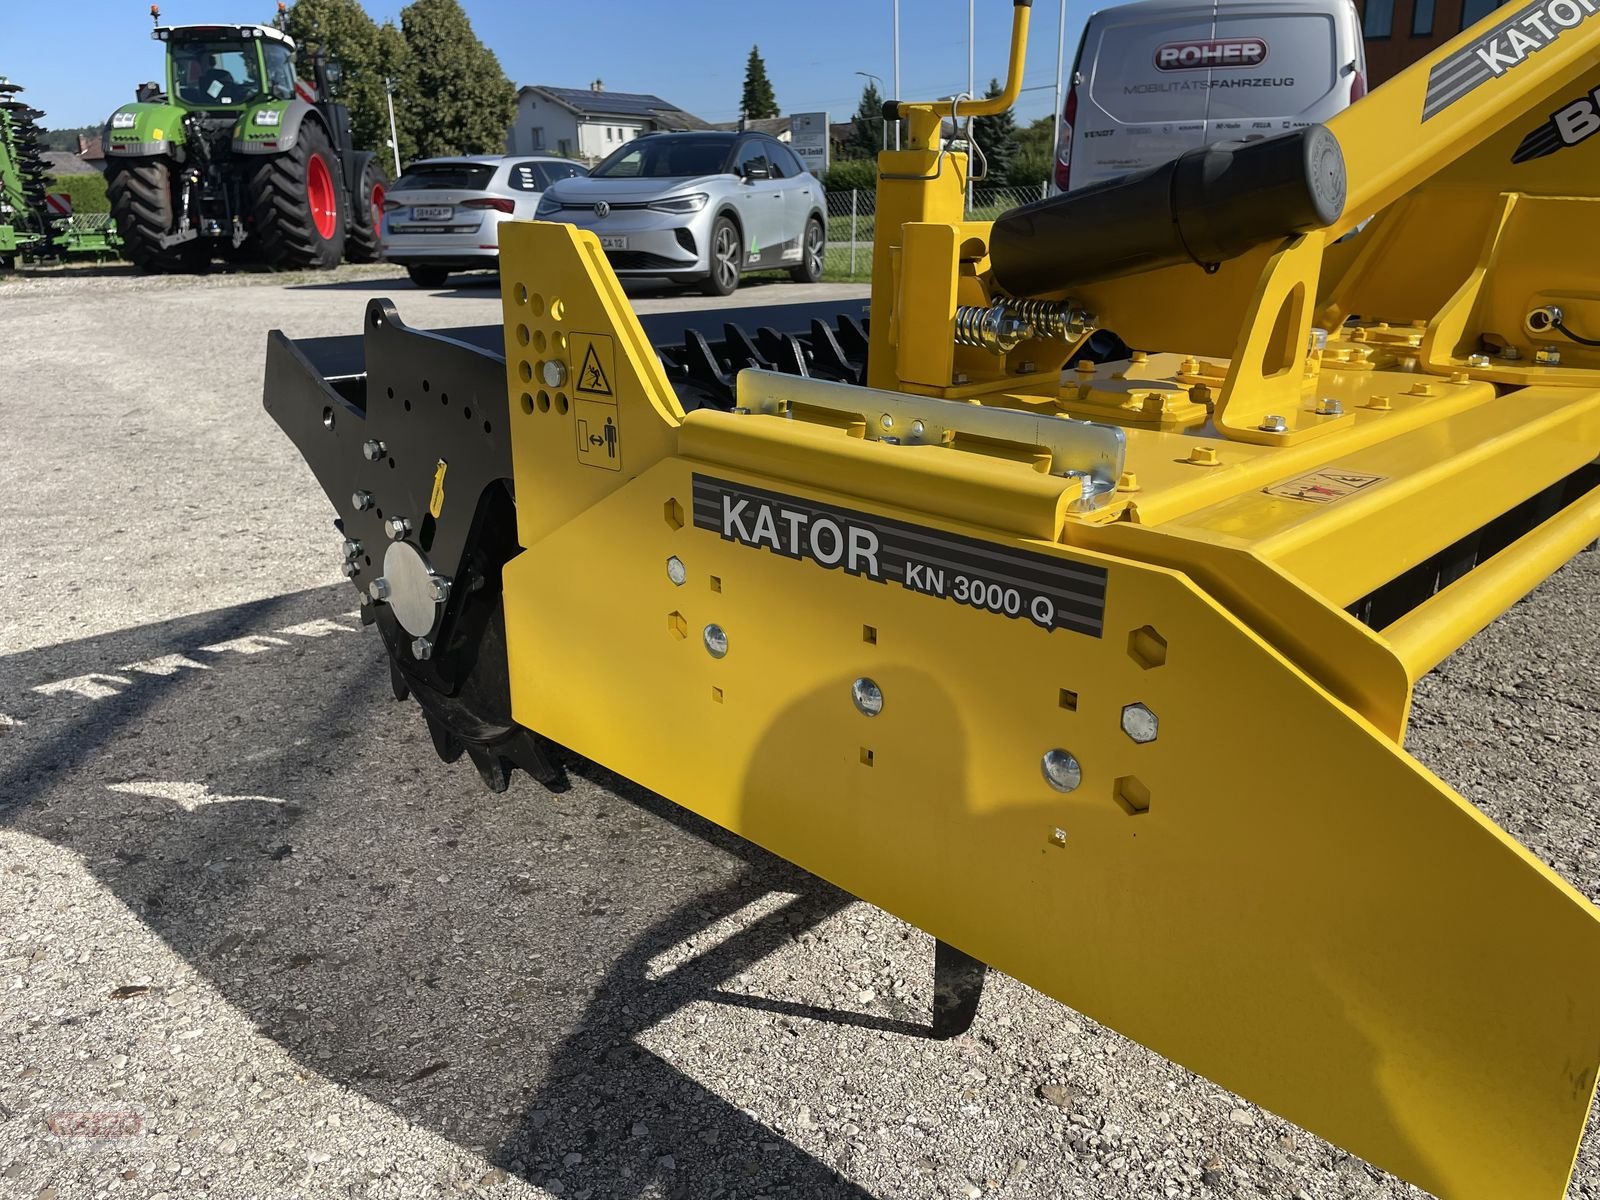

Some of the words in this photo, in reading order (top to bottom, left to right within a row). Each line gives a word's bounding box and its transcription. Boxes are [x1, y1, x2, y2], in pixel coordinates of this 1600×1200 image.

[1160, 43, 1262, 67] ROHER
[723, 495, 879, 577] KATOR
[905, 561, 945, 594] KN
[953, 575, 1021, 615] 3000
[1030, 596, 1055, 626] Q
